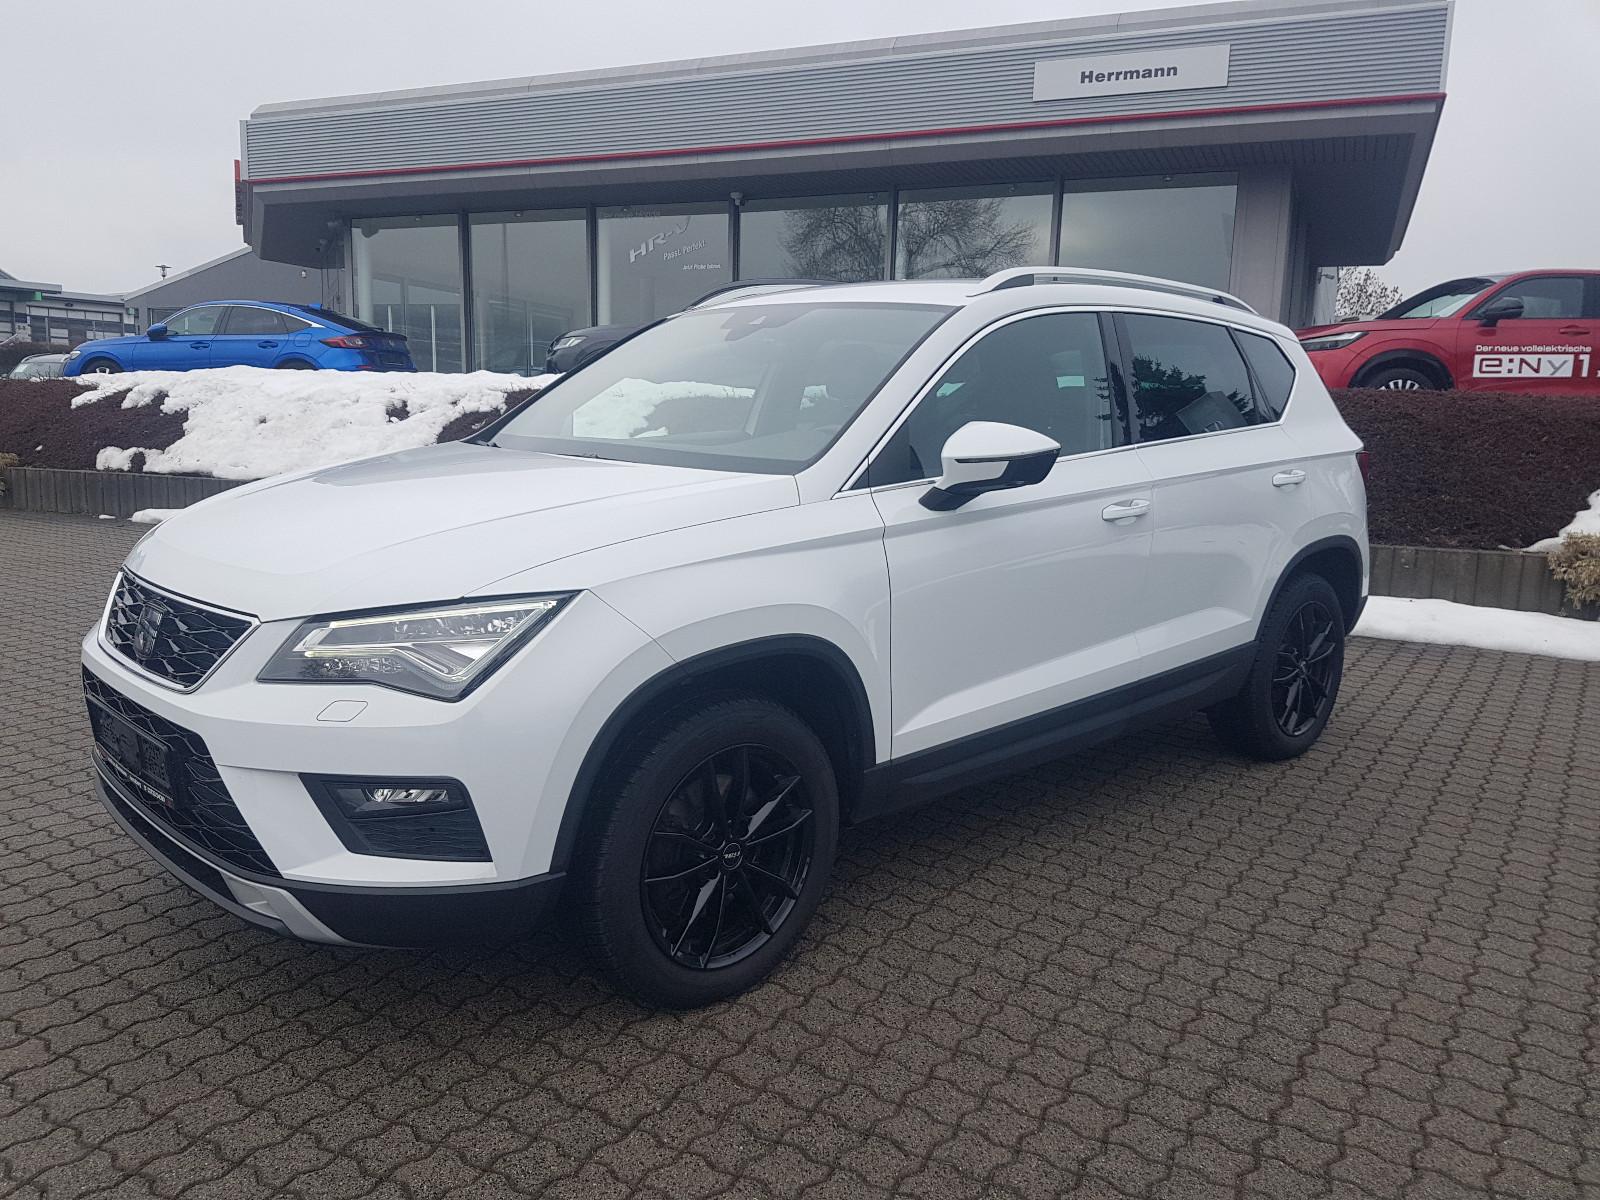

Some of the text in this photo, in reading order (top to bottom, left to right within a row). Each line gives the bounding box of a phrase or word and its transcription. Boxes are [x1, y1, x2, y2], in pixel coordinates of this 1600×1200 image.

[1080, 66, 1178, 84] Herrmann
[1475, 344, 1493, 352] Der
[1521, 343, 1592, 353] vollelektrische
